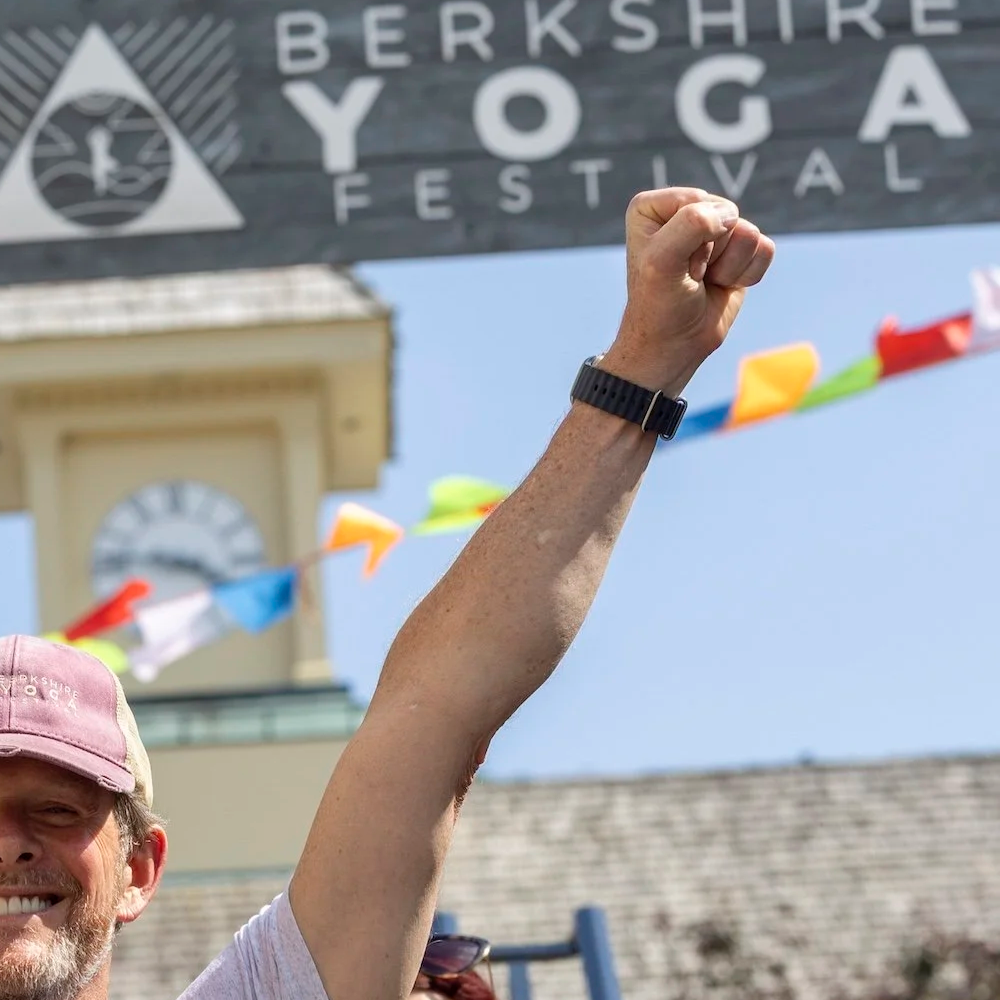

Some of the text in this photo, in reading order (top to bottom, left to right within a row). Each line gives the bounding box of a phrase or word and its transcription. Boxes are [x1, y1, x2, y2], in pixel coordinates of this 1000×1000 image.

[275, 0, 962, 74] BERKSHIRE
[282, 45, 971, 174] YOGA
[333, 144, 923, 225] FESTIVAL
